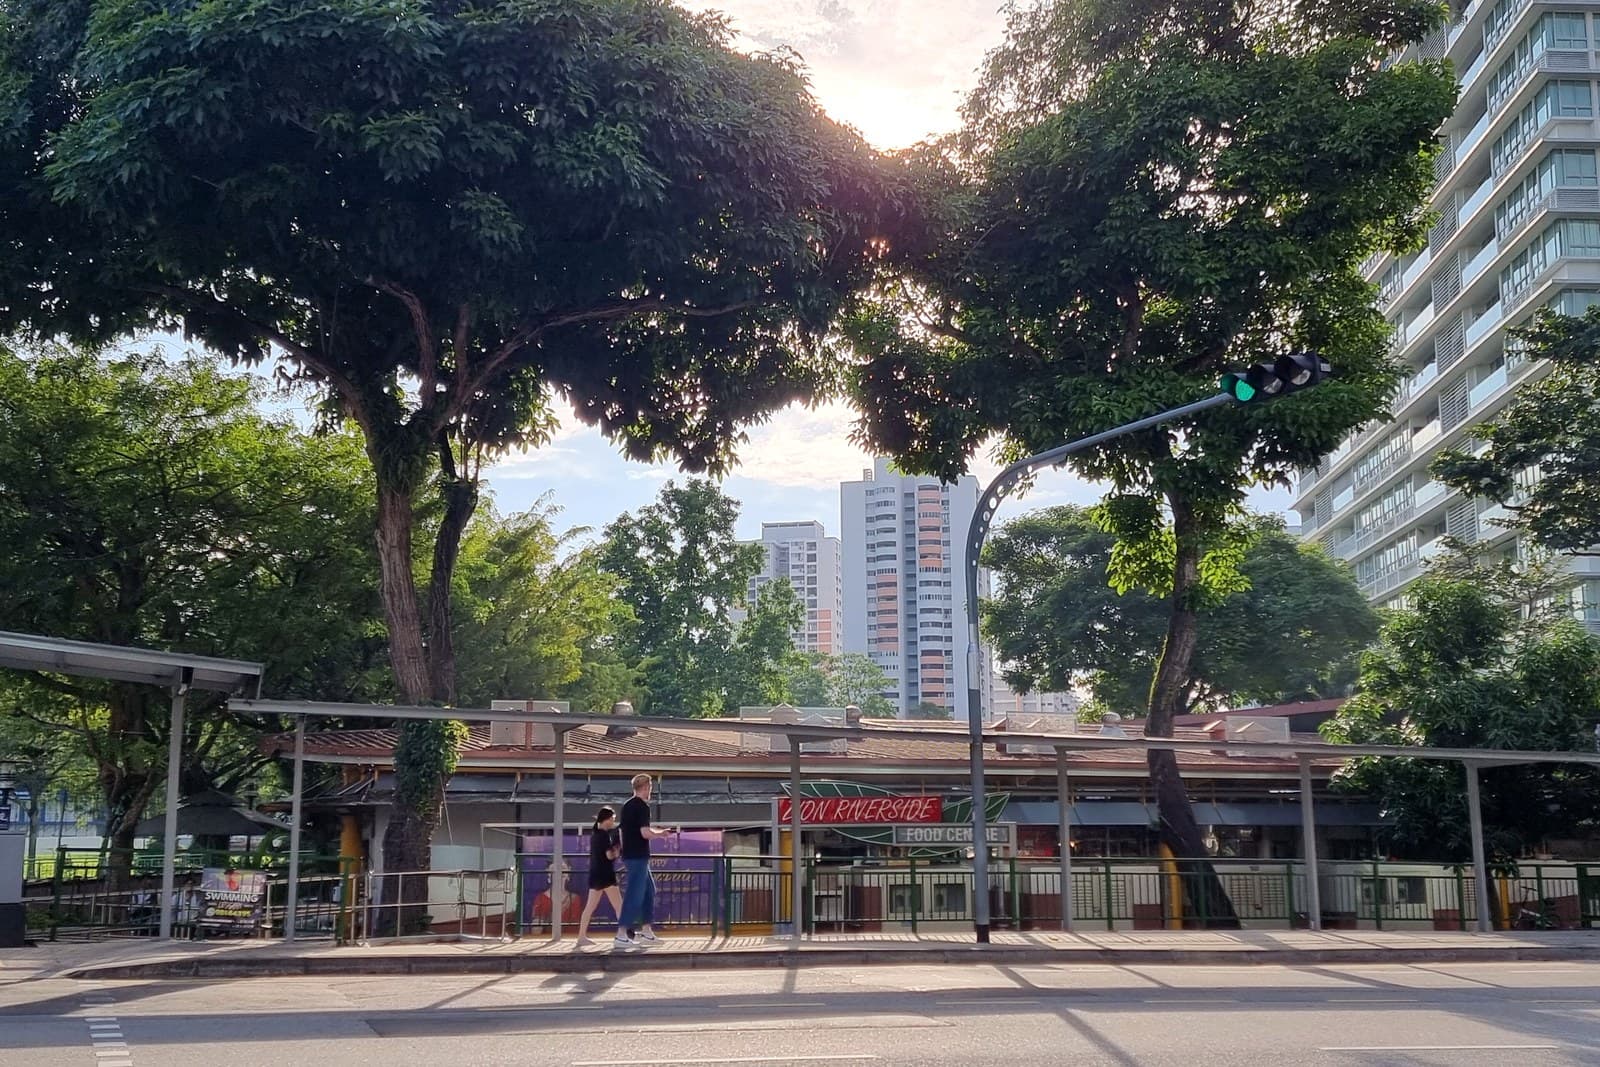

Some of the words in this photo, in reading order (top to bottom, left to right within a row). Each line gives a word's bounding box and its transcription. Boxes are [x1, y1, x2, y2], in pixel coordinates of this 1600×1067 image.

[834, 798, 937, 821] RIVERSIDE
[906, 828, 941, 841] FOOD
[947, 828, 998, 841] CENE
[205, 892, 259, 902] SWIMMING
